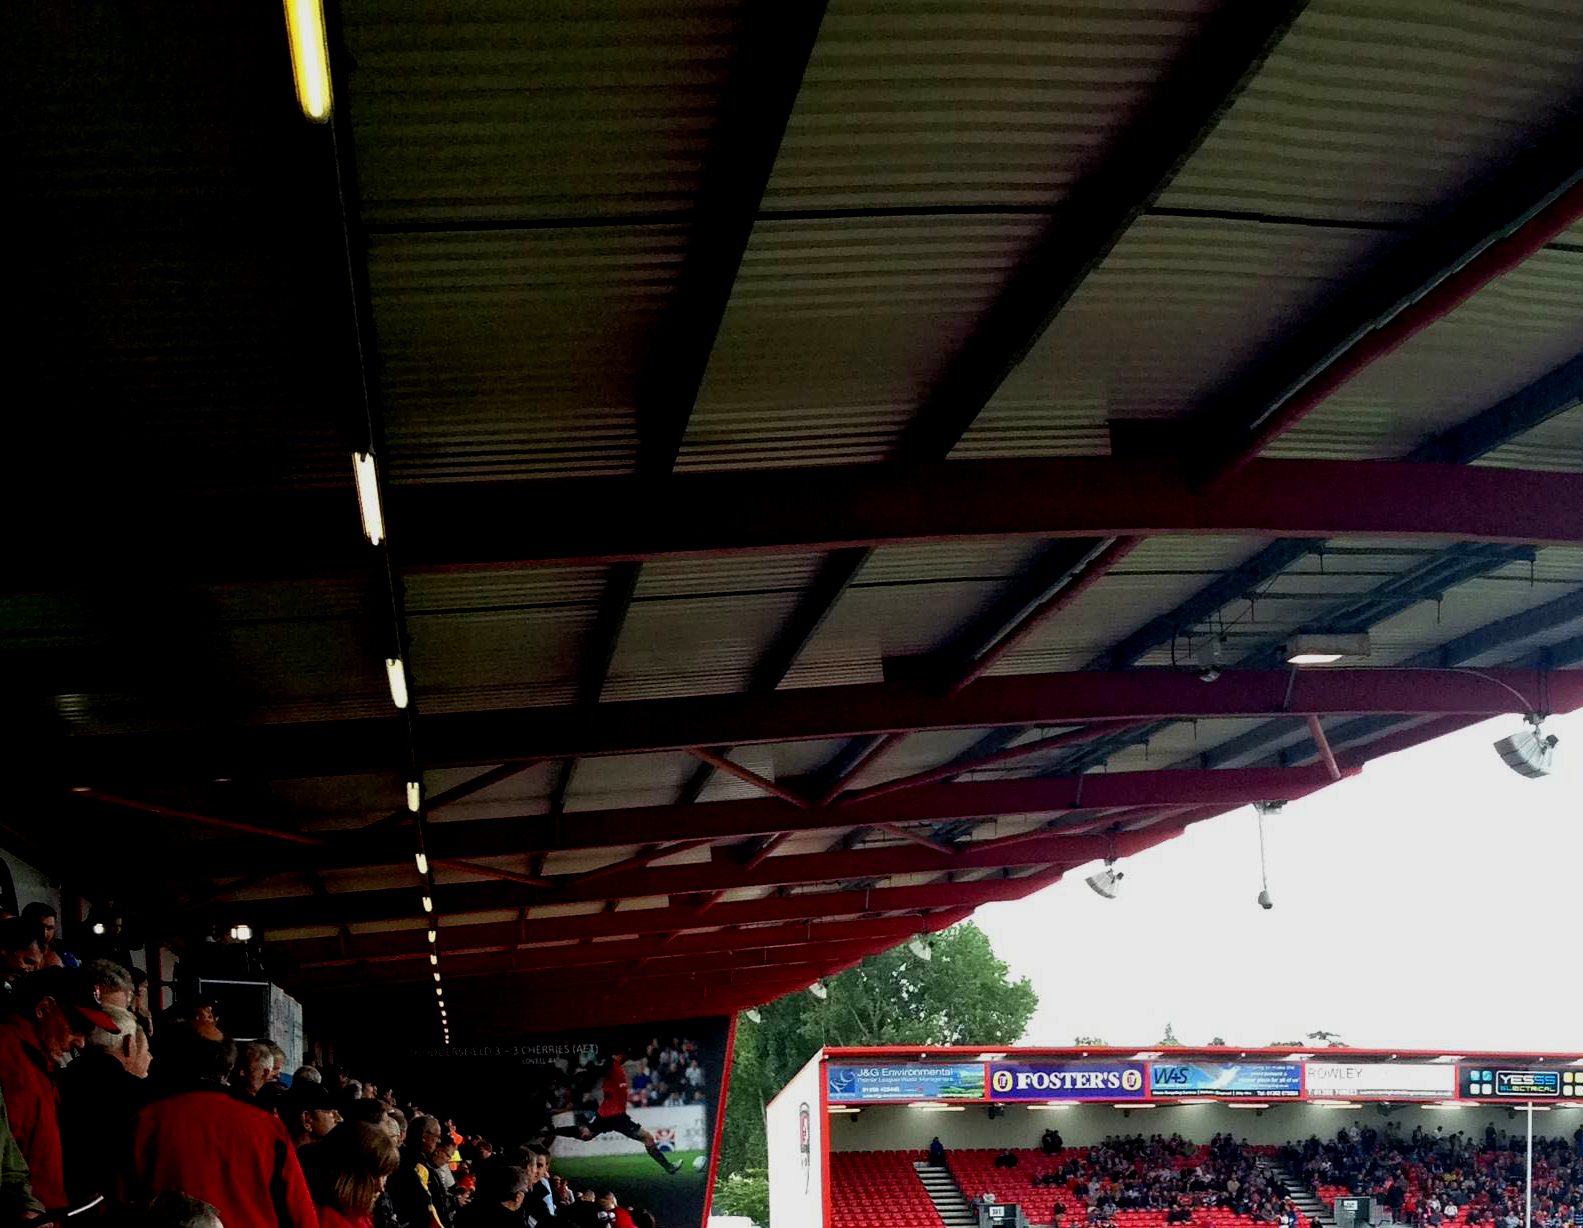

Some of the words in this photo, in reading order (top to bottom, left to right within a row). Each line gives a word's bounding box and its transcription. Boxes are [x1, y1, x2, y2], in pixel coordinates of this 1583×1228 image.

[522, 1044, 570, 1056] CHERRIES
[857, 1068, 879, 1077] J&G
[882, 1067, 954, 1078] Environmental
[1307, 1068, 1363, 1079] ROWLEY
[1016, 1072, 1119, 1090] FOSTER'S
[1499, 1074, 1556, 1085] YESSS
